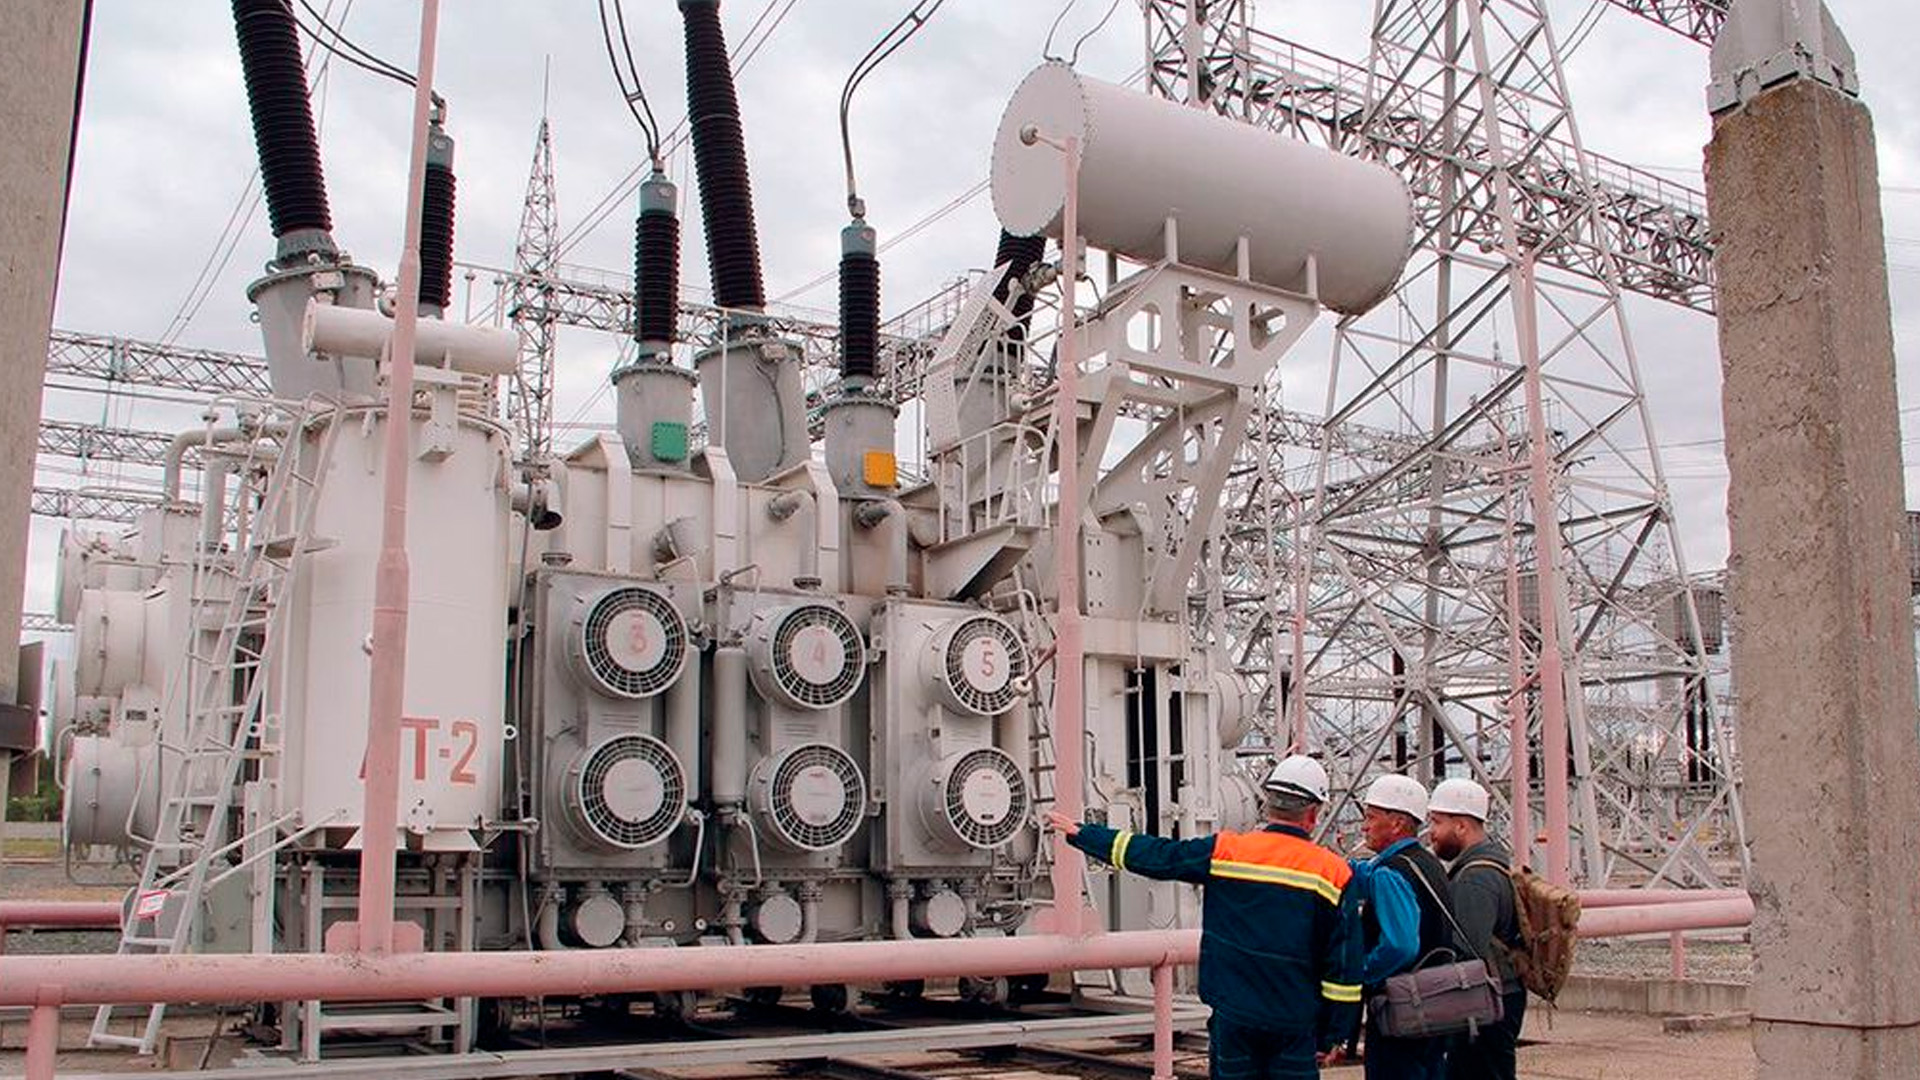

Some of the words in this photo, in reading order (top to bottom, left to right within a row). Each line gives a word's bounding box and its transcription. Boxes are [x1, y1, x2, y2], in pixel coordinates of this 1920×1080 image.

[630, 625, 647, 654] 3
[982, 651, 995, 677] 5
[358, 717, 479, 784] Т-2
